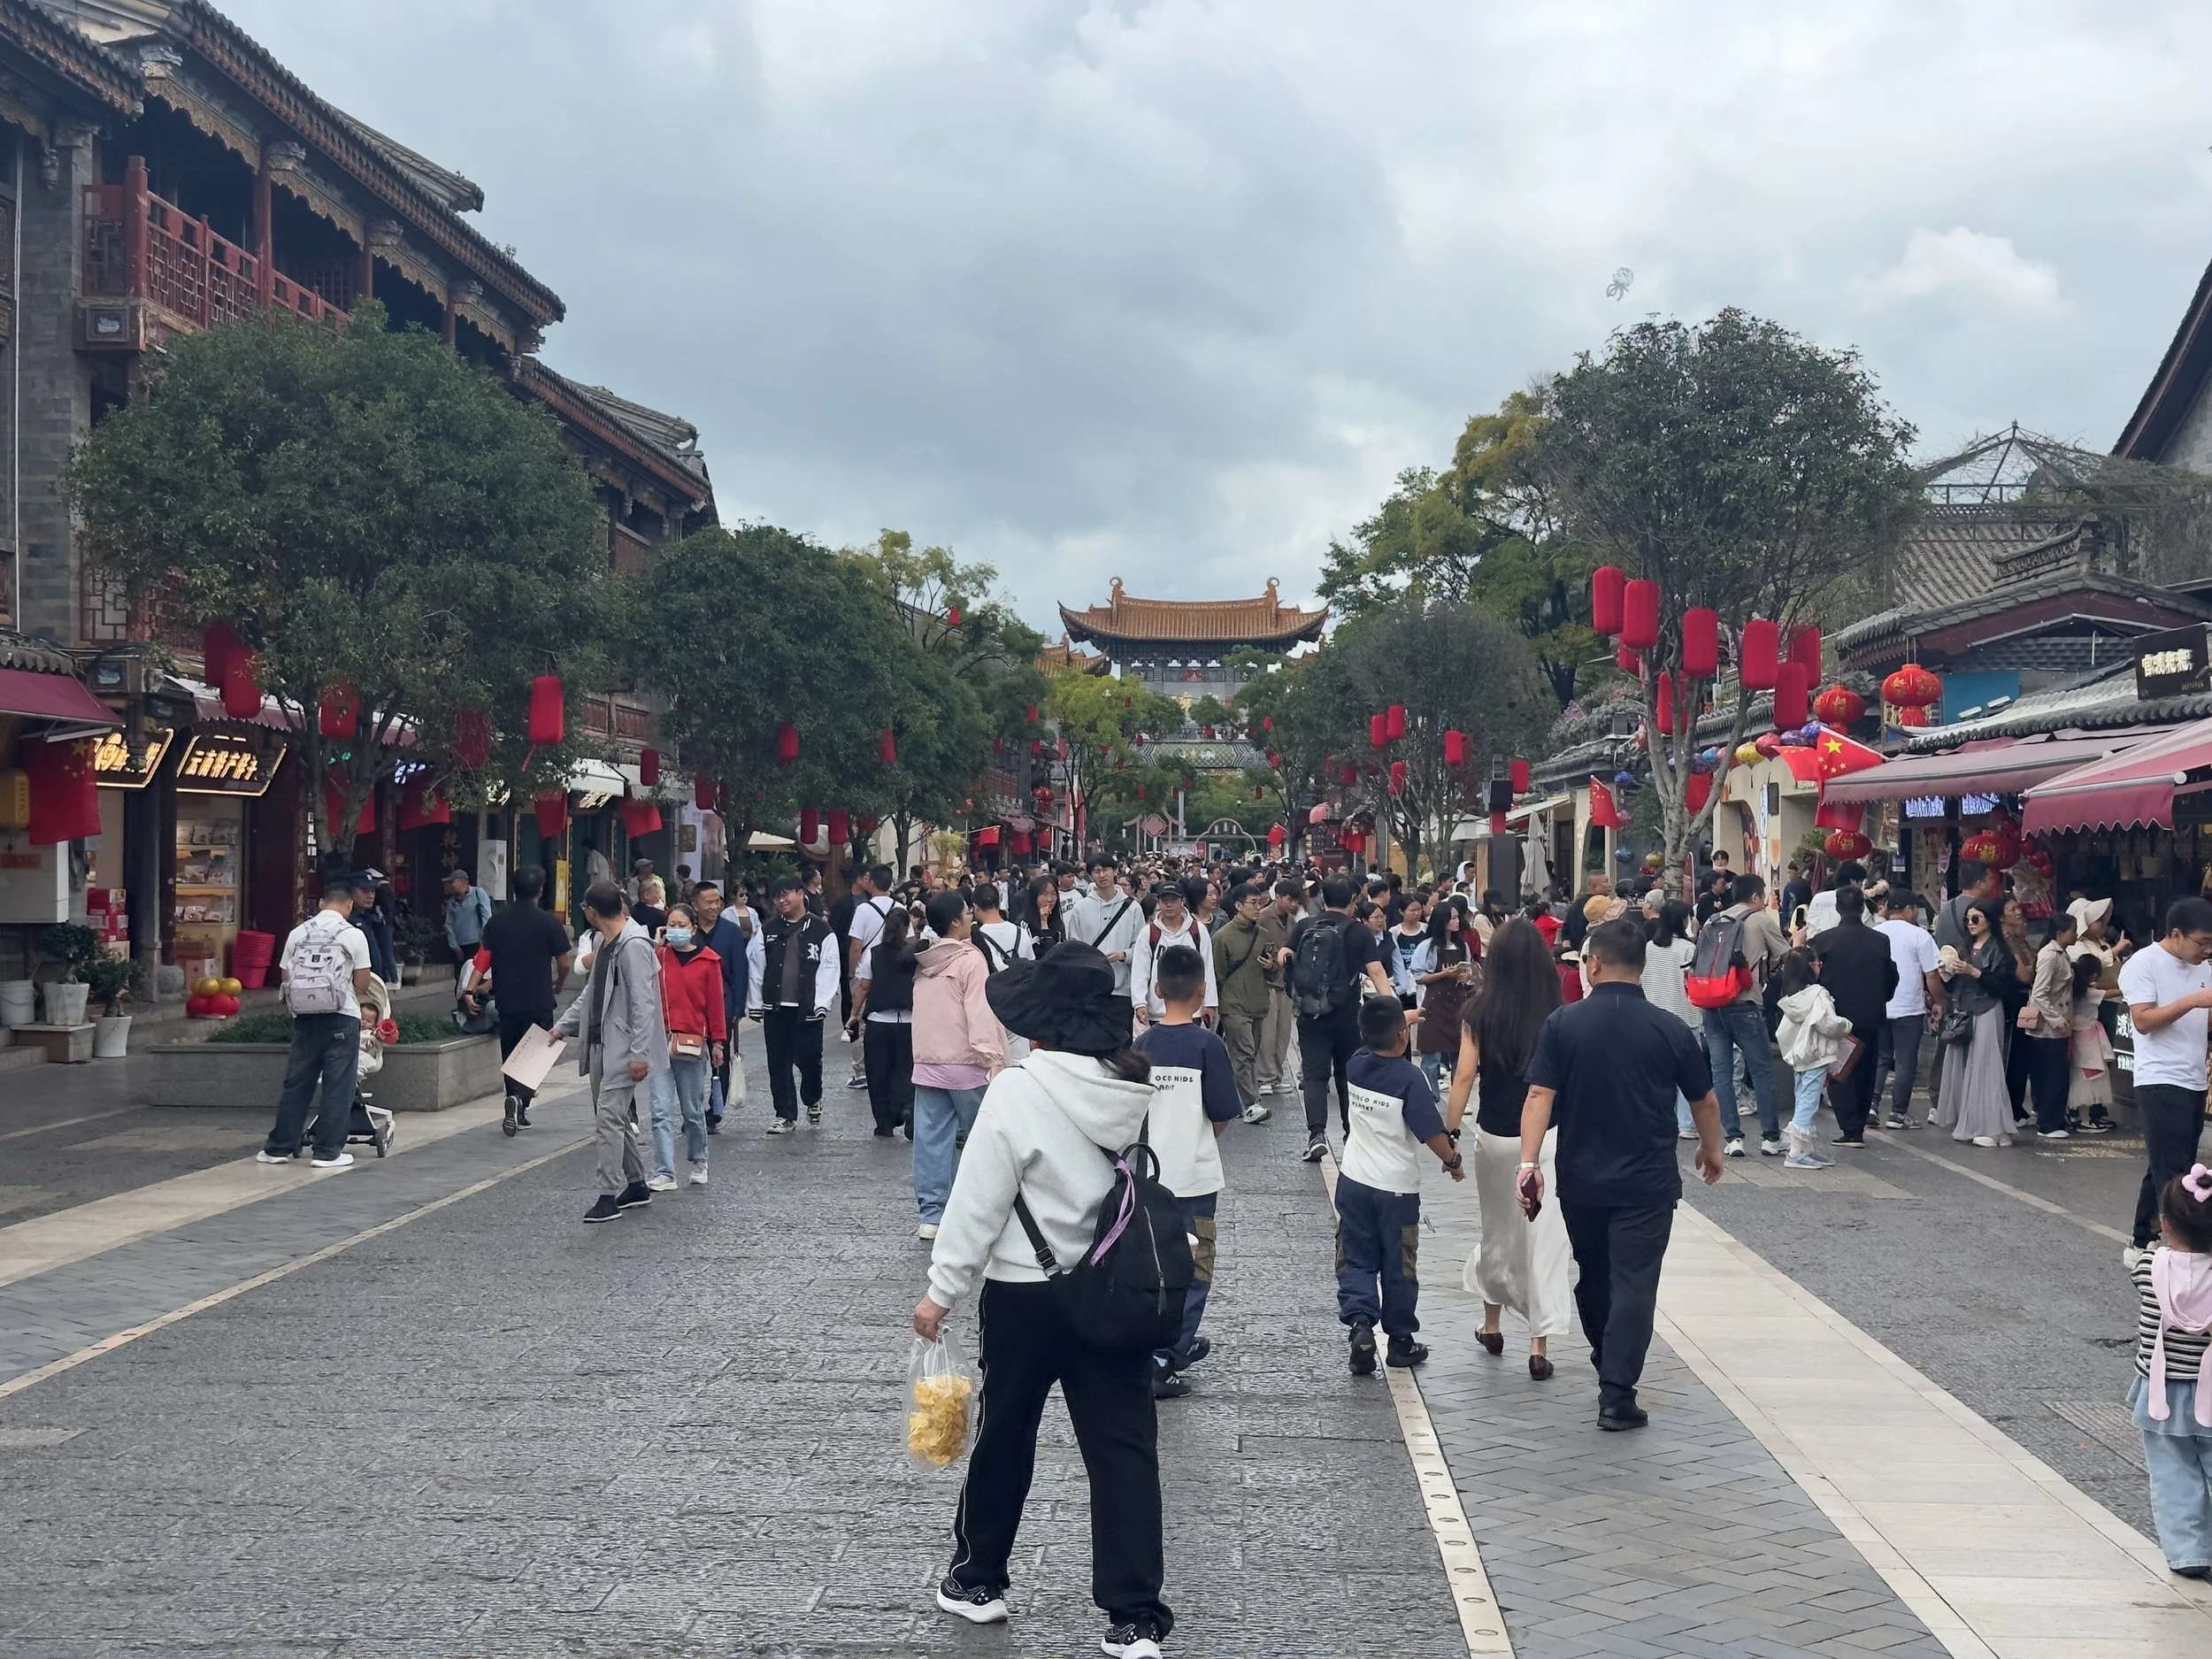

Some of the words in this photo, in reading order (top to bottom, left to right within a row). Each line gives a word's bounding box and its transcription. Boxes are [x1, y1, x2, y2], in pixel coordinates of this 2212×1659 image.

[185, 749, 259, 781] 云南特产伴手
[1373, 1099, 1390, 1108] KIDS
